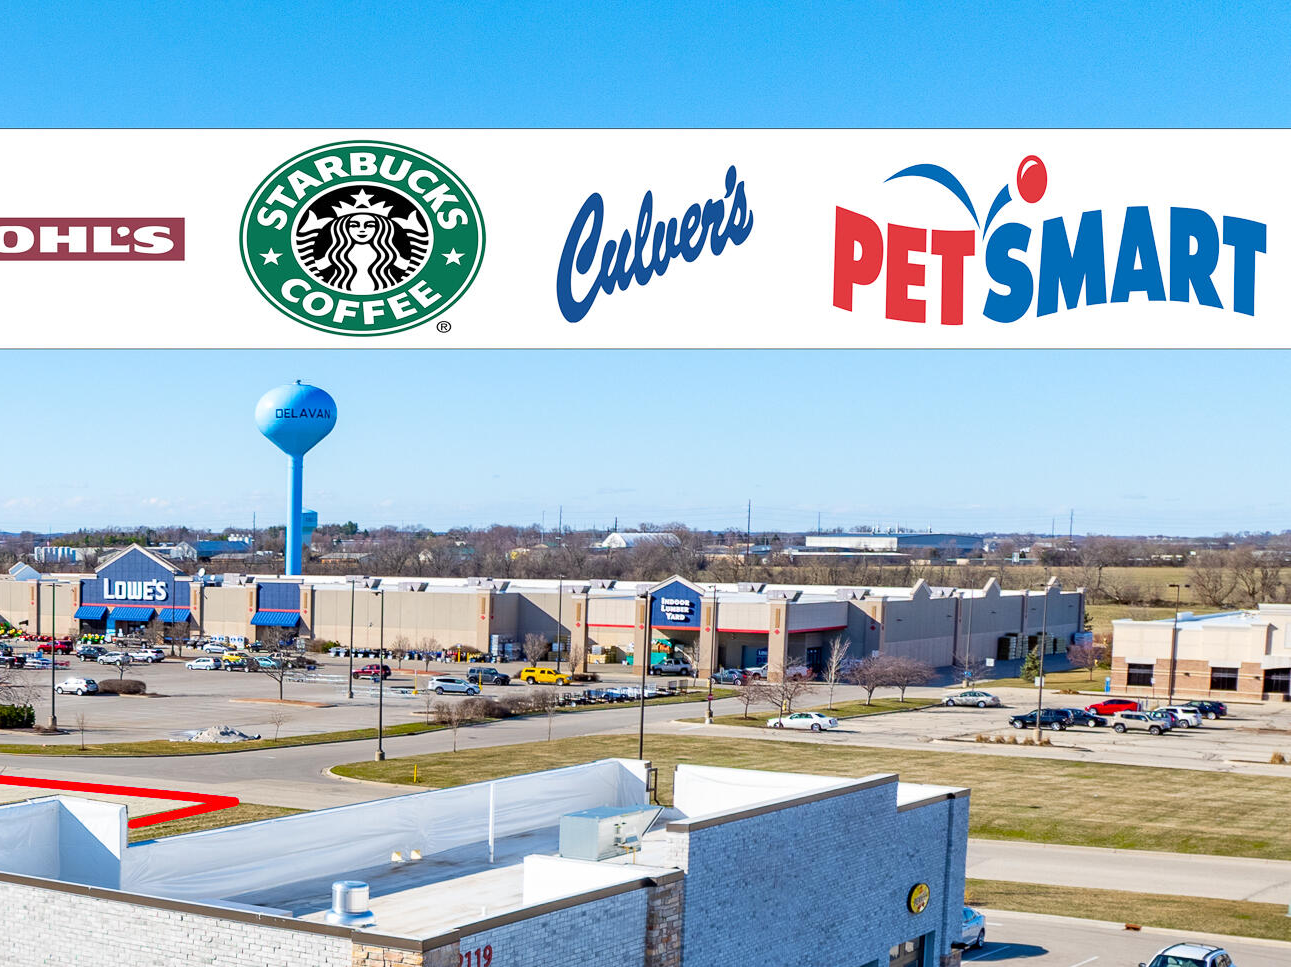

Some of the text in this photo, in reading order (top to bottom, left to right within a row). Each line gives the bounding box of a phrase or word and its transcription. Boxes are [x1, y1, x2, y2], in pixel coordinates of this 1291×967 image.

[275, 408, 331, 419] DELAVAN
[103, 577, 168, 601] LOWE'S
[660, 597, 690, 606] INDOOR
[665, 612, 686, 621] YARD
